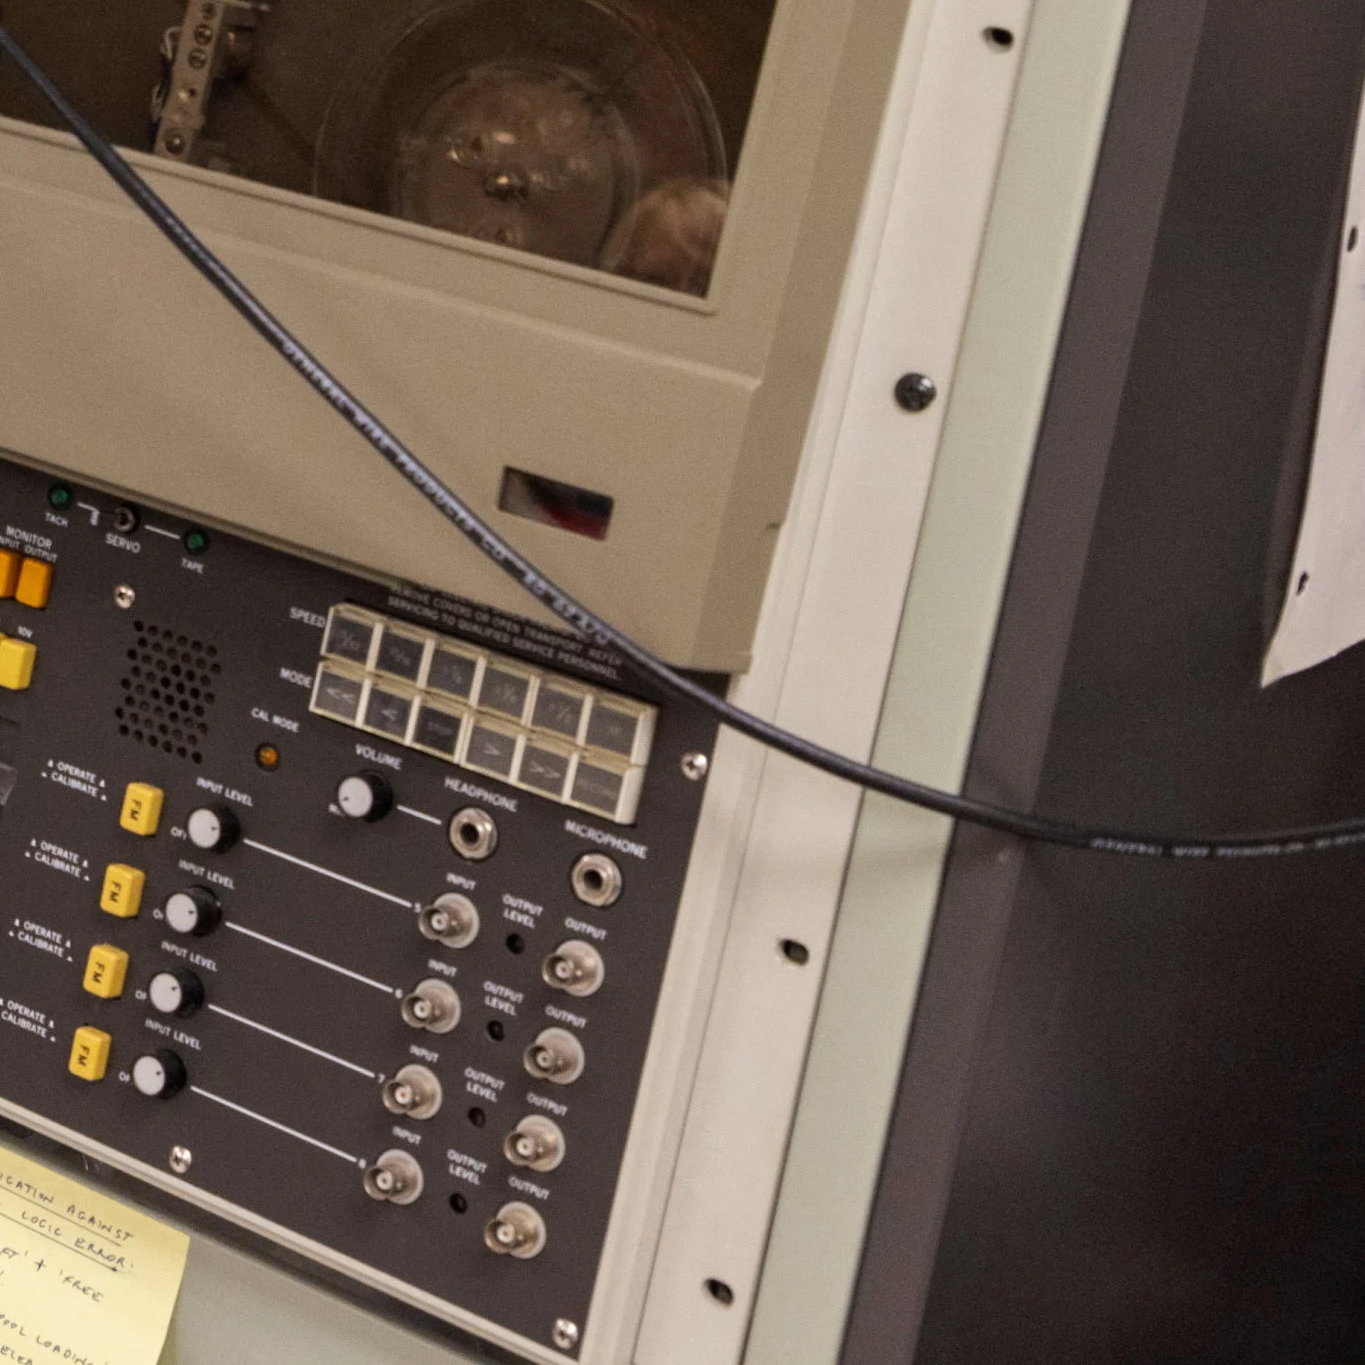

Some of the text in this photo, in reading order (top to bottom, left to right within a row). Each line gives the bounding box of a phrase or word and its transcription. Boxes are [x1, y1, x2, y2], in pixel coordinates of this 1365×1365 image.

[5, 525, 53, 550] MONITOR
[105, 532, 141, 554] SERVO
[289, 606, 326, 629] SPEED
[354, 743, 403, 771] VOLUME
[444, 776, 518, 813] HEADPHONE
[563, 819, 649, 860] MICROPHONE
[66, 1204, 135, 1242] AGAINST
